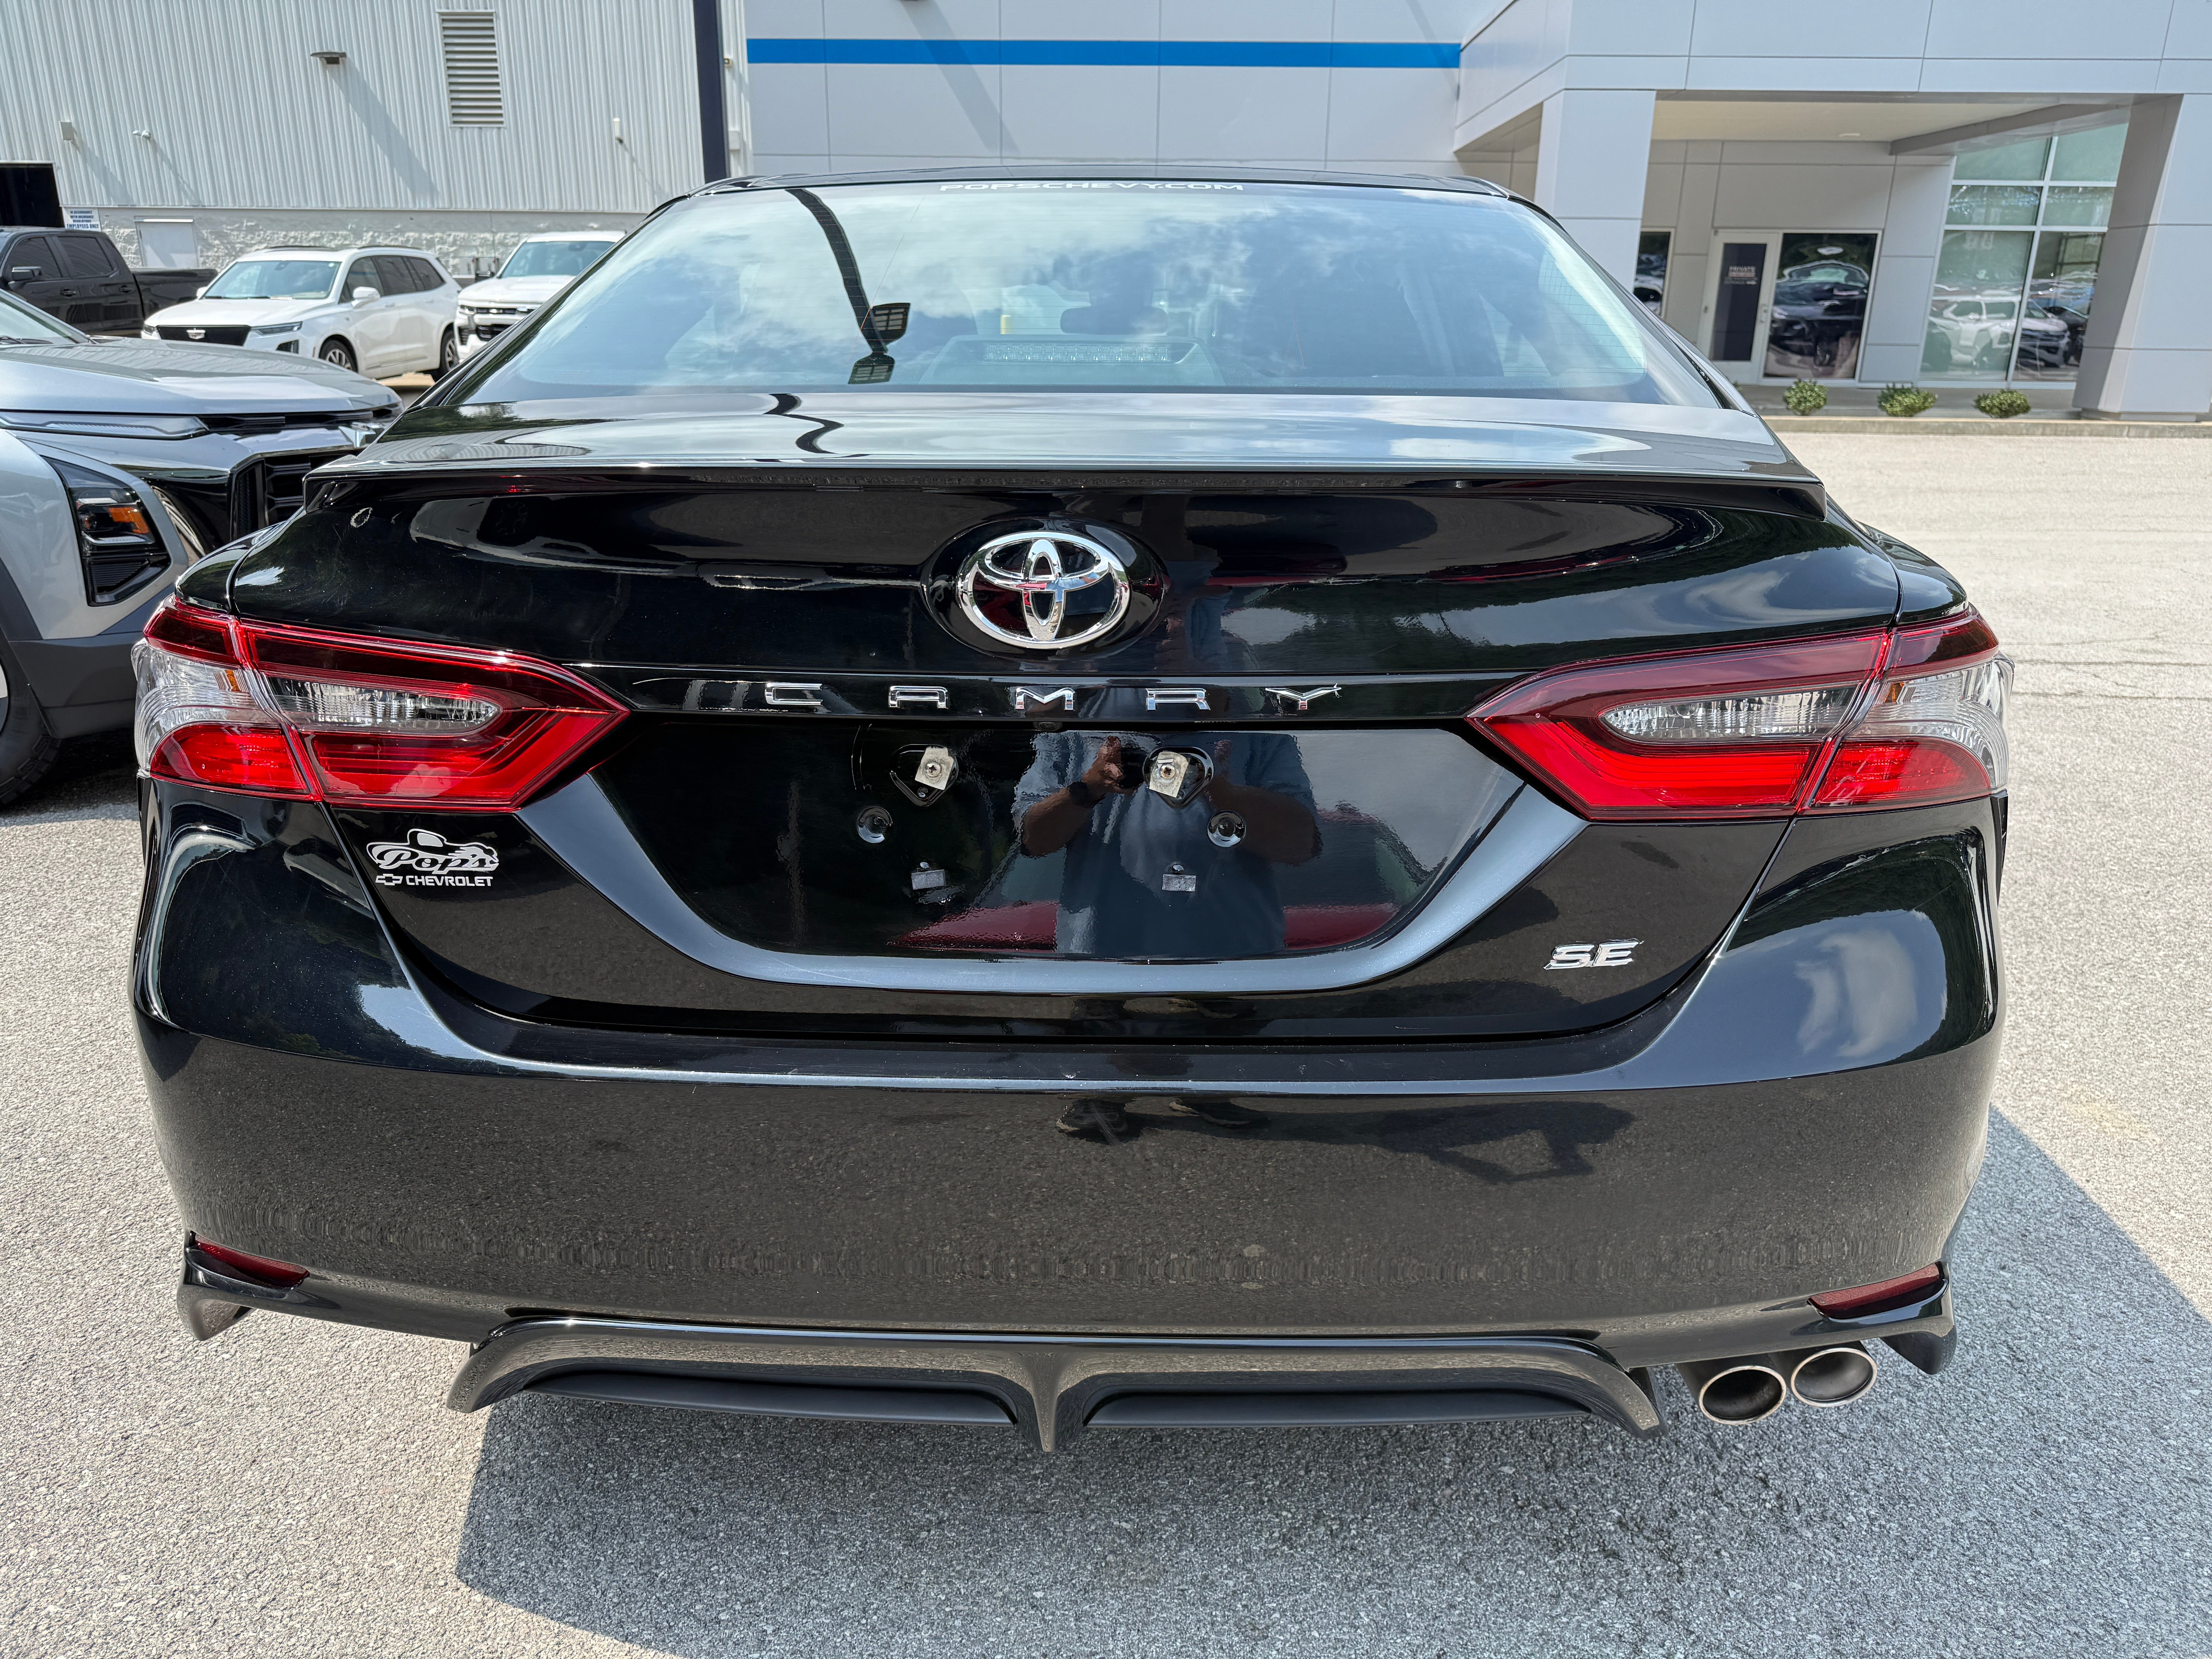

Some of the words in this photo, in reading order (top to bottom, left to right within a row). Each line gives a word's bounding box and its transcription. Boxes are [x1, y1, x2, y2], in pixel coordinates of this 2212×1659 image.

[939, 183, 1243, 191] POPSCHEVY.COM
[765, 683, 1341, 710] CAMRY
[406, 876, 493, 886] CHEVROLET
[1543, 941, 1639, 970] SE
